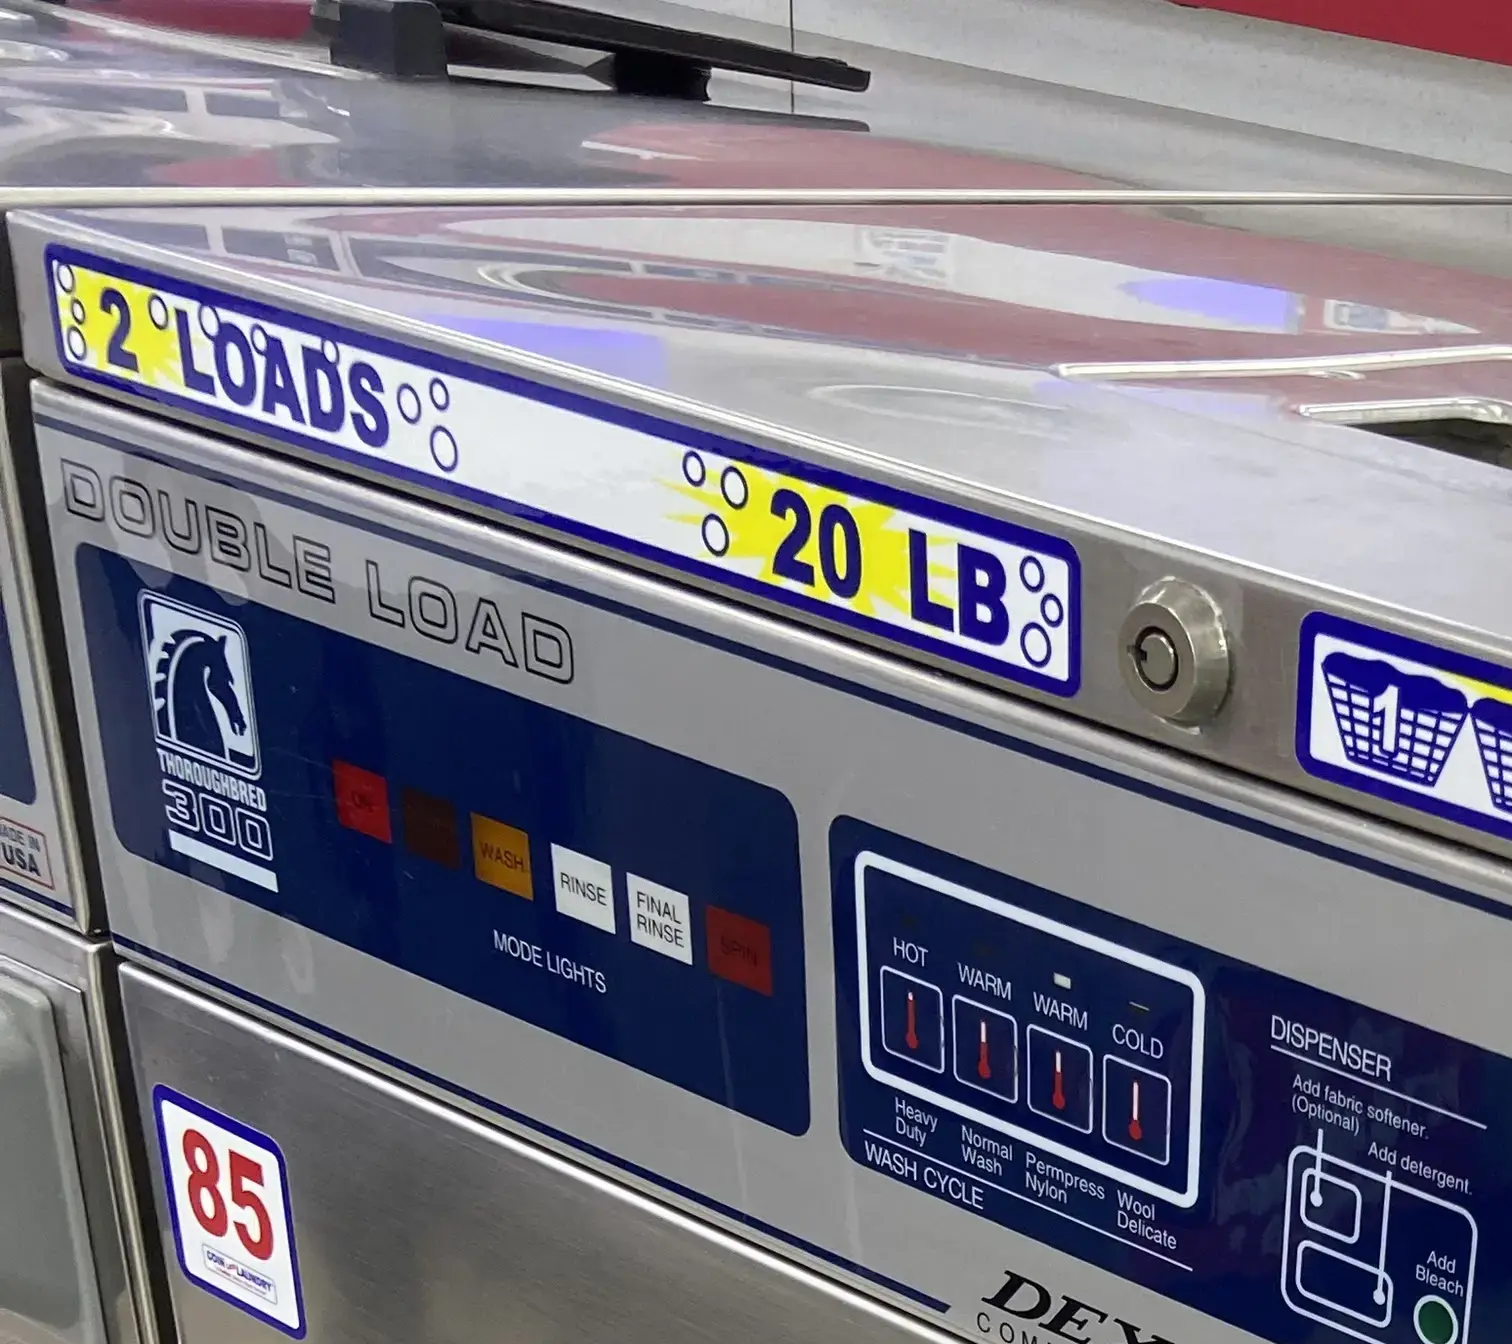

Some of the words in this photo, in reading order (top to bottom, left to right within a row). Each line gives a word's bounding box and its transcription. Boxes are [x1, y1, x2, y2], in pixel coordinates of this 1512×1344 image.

[100, 288, 139, 374] 2
[174, 304, 390, 448] LOADS
[60, 458, 337, 602] DOUBLE
[366, 559, 575, 686] LOAD
[769, 488, 863, 600] 20
[908, 528, 1010, 646] LB
[1373, 683, 1401, 755] 1
[156, 748, 268, 813] THOROUGHBRED
[161, 778, 274, 862] 300
[1, 841, 42, 878] USA
[478, 840, 526, 873] WASH
[559, 872, 608, 907] RINSE
[636, 891, 682, 925] FINAL
[636, 914, 685, 949] RINSE
[892, 936, 930, 967] HOT
[492, 928, 543, 967] MODE
[547, 950, 607, 994] LIGHTS
[957, 962, 1012, 1001] WARM
[1032, 990, 1088, 1032] WARM
[1111, 1023, 1164, 1060] COLD
[1270, 1014, 1393, 1083] DISPENSER
[895, 1096, 938, 1133] Heavy
[1291, 1073, 1321, 1099] Add
[1324, 1083, 1364, 1116] fabric
[1366, 1102, 1430, 1141] softener.
[1291, 1094, 1361, 1137] (Optional)
[895, 1116, 928, 1148] Duty
[961, 1124, 1013, 1162] Normal
[863, 1139, 918, 1182] WASH
[923, 1166, 985, 1211] CYCLE
[961, 1144, 1003, 1177] Wash
[1025, 1151, 1106, 1200] Permpress
[1367, 1140, 1398, 1167] Add
[1400, 1155, 1474, 1197] detergent.
[181, 1127, 275, 1262] 85
[1025, 1171, 1068, 1204] Nylon
[1116, 1189, 1156, 1222] Wool
[1117, 1210, 1178, 1251] Delicate
[1414, 1263, 1465, 1298] Bleach
[1426, 1249, 1457, 1275] Add
